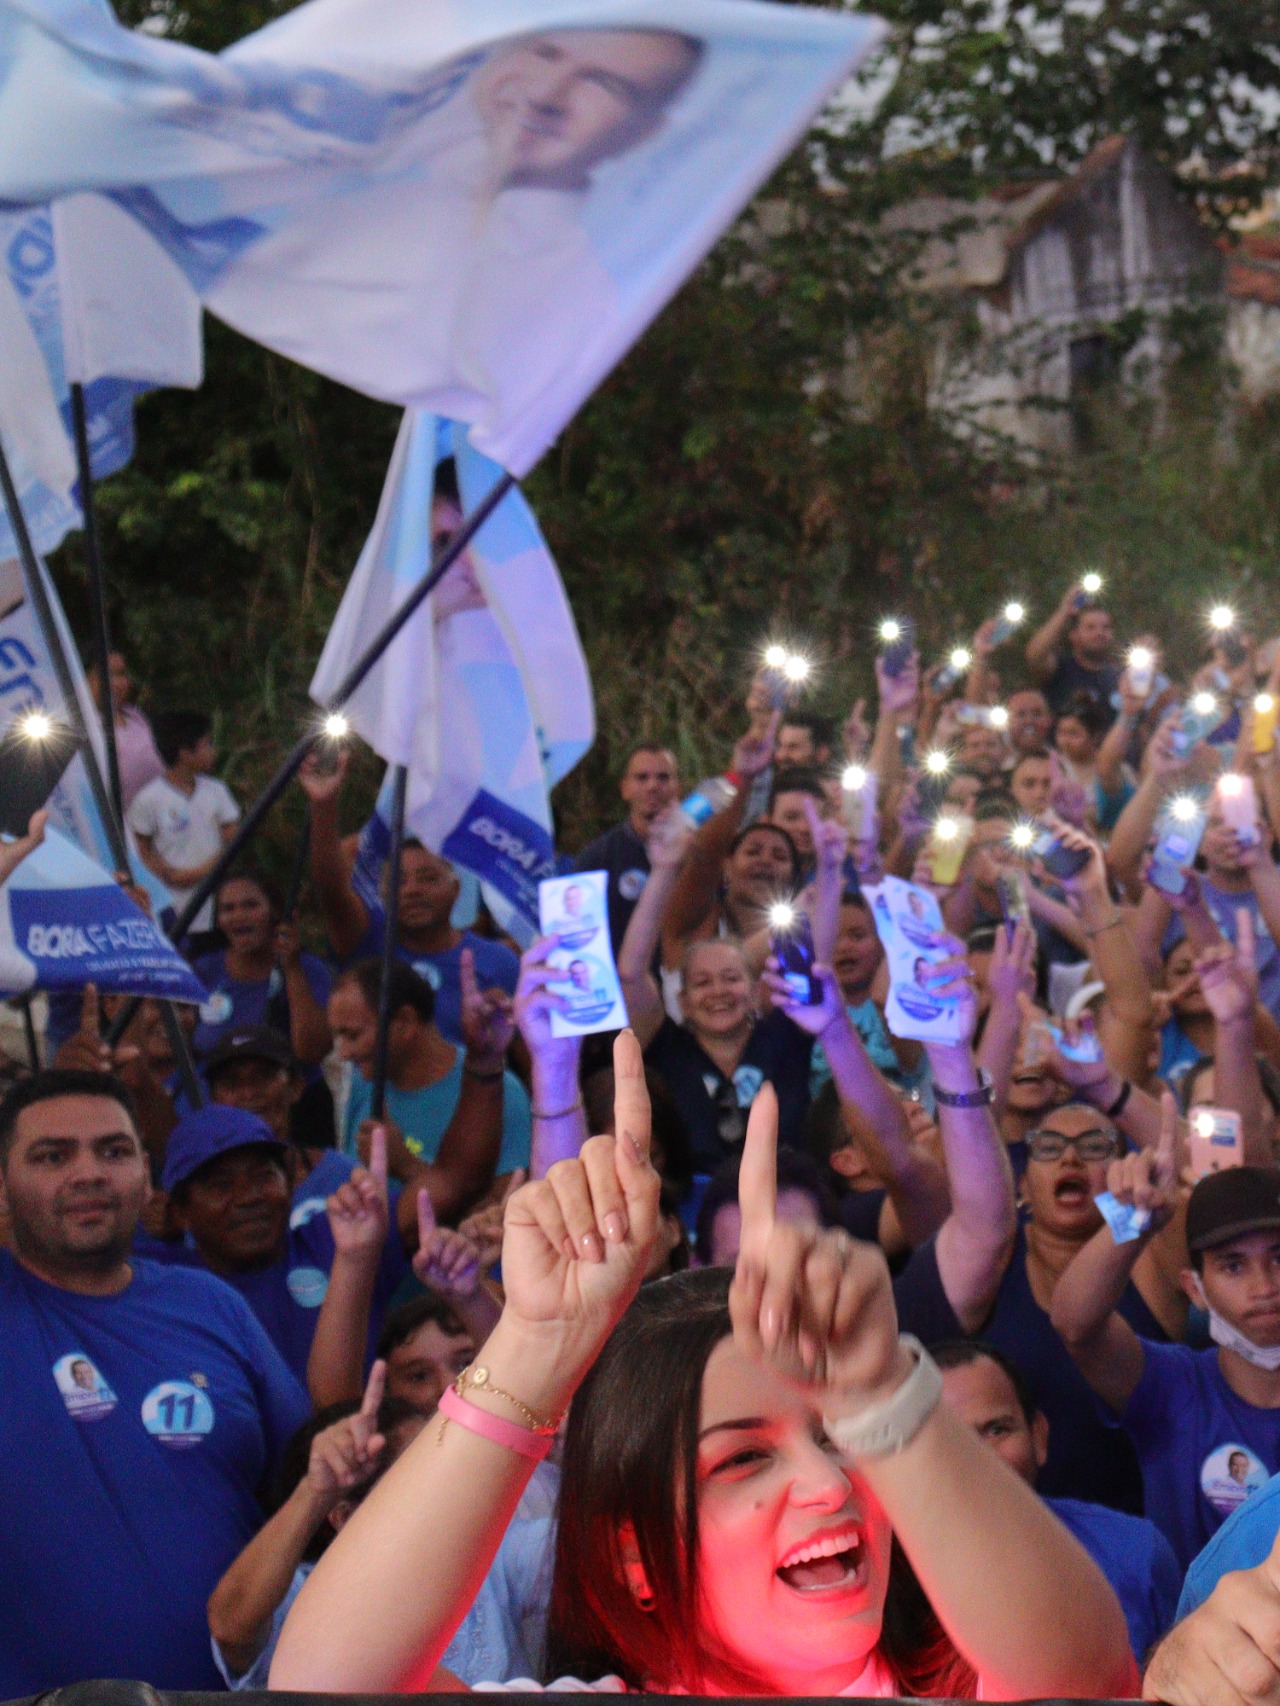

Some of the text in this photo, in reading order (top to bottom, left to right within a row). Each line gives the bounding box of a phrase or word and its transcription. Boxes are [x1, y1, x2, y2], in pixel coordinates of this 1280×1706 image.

[468, 816, 537, 869] BORA
[27, 922, 96, 958] BORA
[159, 1392, 196, 1430] 11
